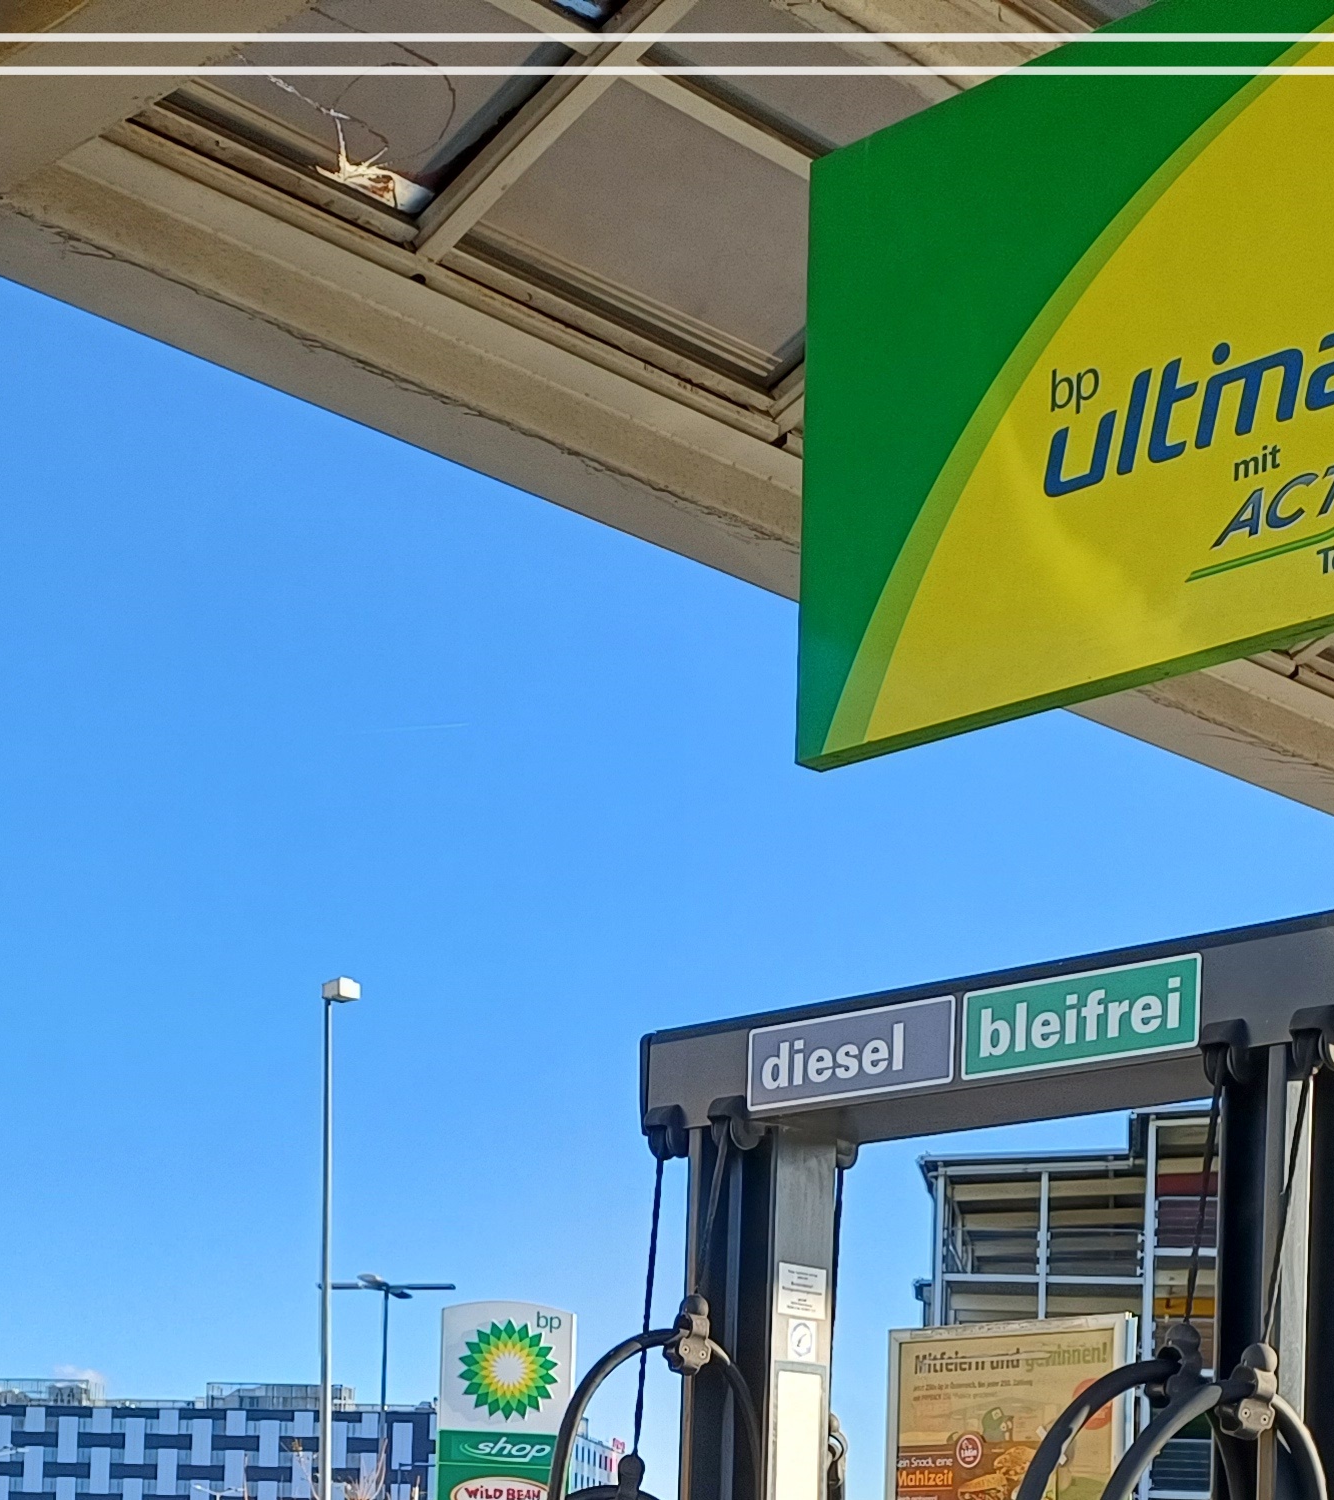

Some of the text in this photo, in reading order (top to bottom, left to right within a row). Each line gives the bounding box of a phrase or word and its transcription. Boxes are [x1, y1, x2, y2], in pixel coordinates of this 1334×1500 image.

[1049, 366, 1101, 412] bp
[1232, 444, 1282, 482] mit
[979, 978, 1182, 1059] bleifrei
[760, 1022, 906, 1091] diesel
[535, 1311, 562, 1331] bp
[990, 1348, 1021, 1370] und
[478, 1436, 551, 1463] shop
[506, 1488, 542, 1500] BEAN
